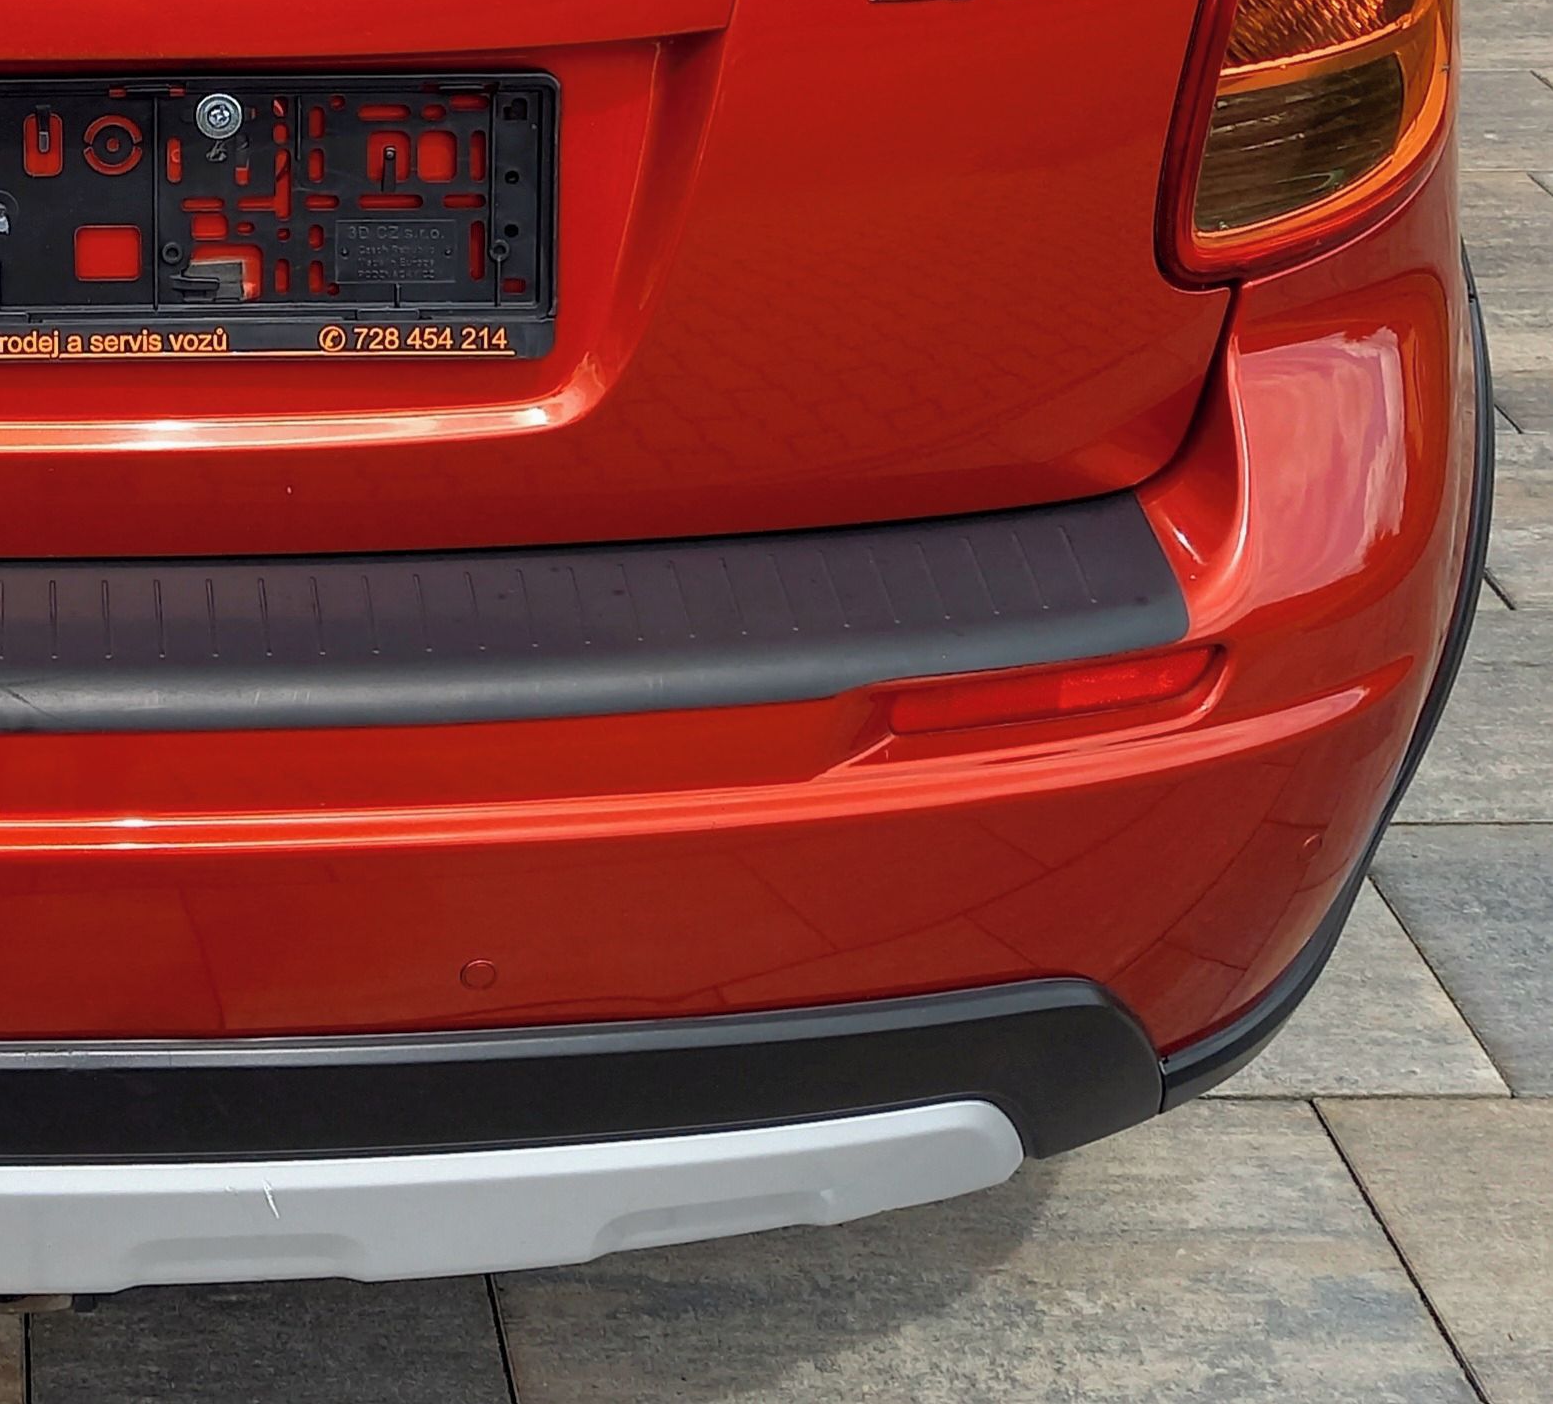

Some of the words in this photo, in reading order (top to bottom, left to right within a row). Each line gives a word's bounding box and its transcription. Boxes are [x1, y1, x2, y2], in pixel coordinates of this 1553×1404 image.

[348, 225, 370, 239] 3D
[376, 225, 399, 239] CZ
[66, 334, 83, 353] a
[89, 329, 162, 352] servis
[169, 327, 228, 352] vozů
[353, 327, 400, 350] 728
[406, 327, 454, 350] 454
[460, 327, 508, 350] 214
